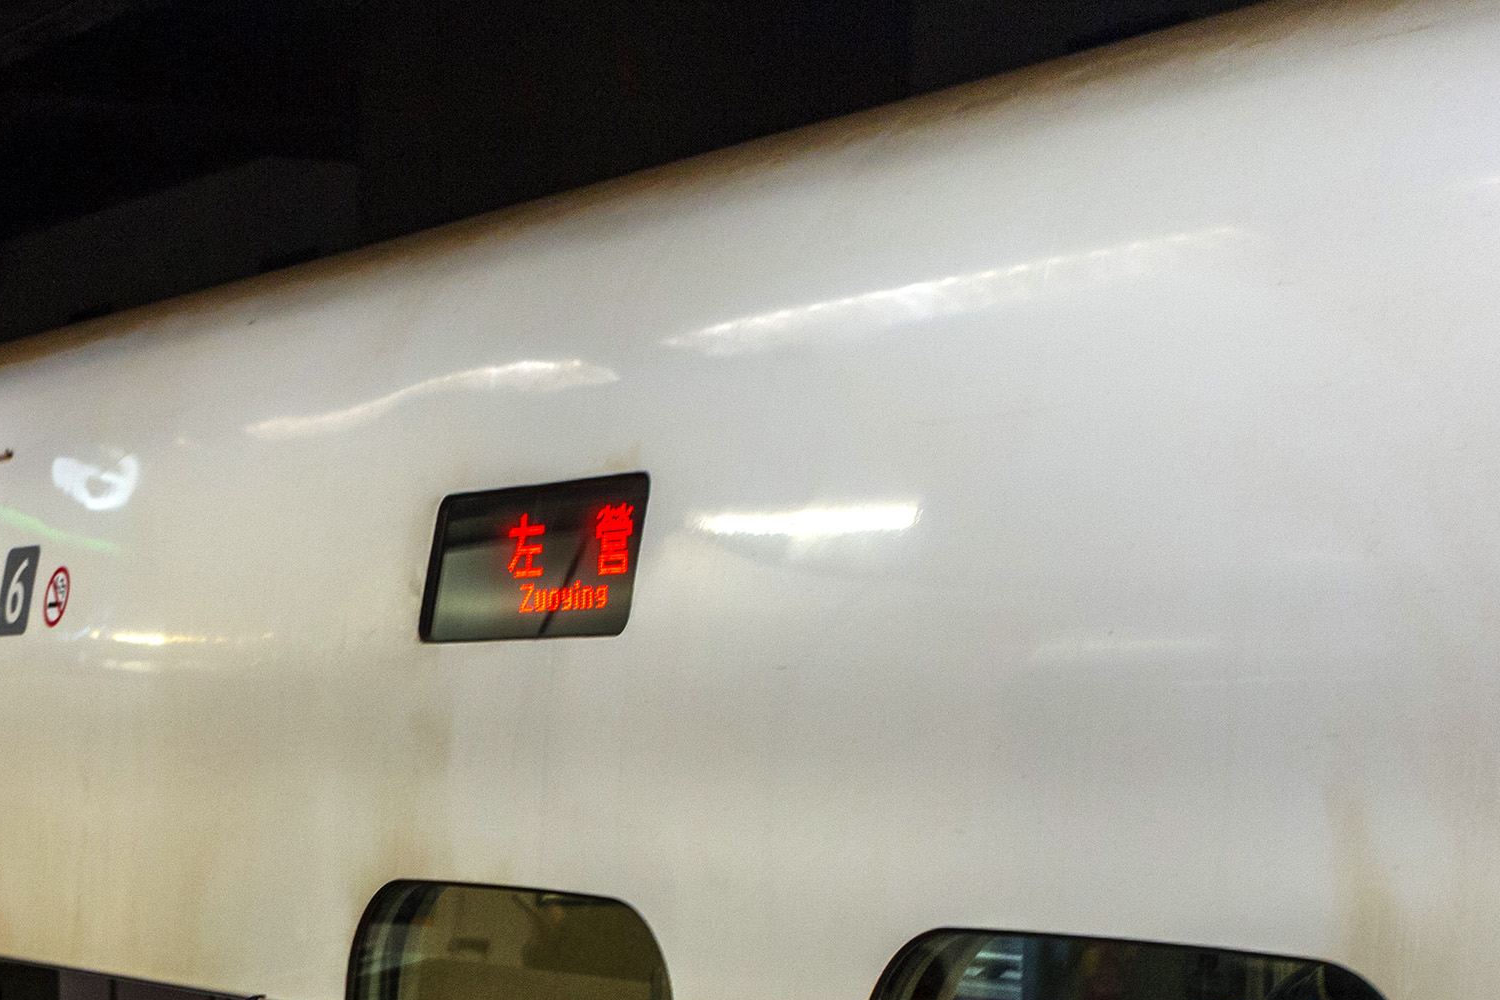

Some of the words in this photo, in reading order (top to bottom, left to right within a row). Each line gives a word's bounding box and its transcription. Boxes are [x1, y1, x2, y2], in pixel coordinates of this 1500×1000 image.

[507, 503, 634, 578] 左營
[4, 557, 30, 625] 6
[518, 580, 609, 613] Zuoying
